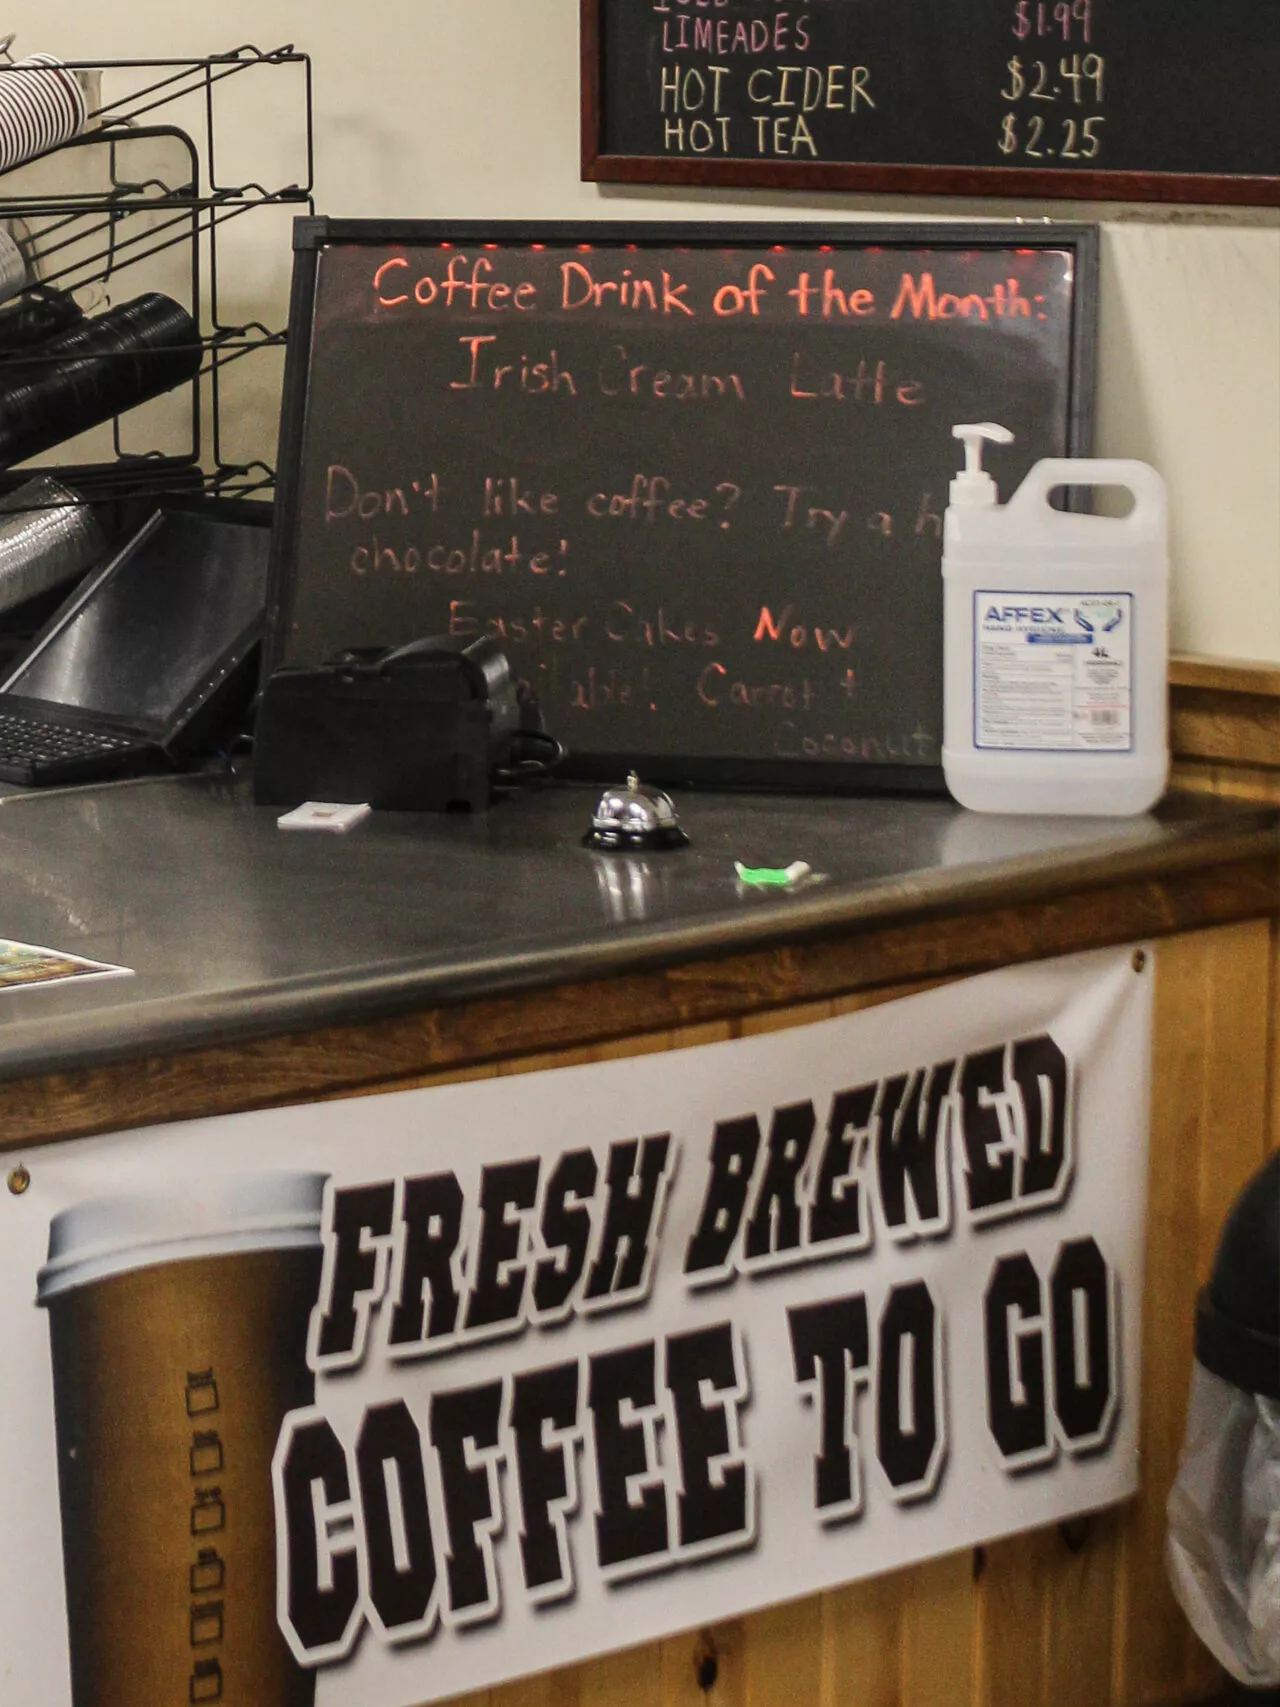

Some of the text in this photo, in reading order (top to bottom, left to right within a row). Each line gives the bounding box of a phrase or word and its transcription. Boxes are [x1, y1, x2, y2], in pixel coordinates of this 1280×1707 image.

[661, 0, 1092, 54] LIMEADES $1.99
[660, 53, 1105, 113] HOT CIDER $2.49
[664, 111, 1106, 158] HOT TEA $2.25
[373, 255, 1049, 322] Coffee Drink of the Month:
[449, 334, 925, 405] Irish Cream Latte
[324, 464, 442, 522] Don't
[483, 476, 559, 517] like
[585, 473, 742, 530] coffee?
[772, 484, 849, 548] Try
[868, 511, 893, 536] a
[350, 528, 569, 577] chocolate!
[448, 599, 589, 644] Easter
[752, 603, 855, 652] Now
[984, 606, 1065, 624] AFFEX
[314, 1031, 1070, 1362] FRESH BREWED
[278, 1320, 750, 1653] COFFEE
[785, 1278, 938, 1512] TO
[983, 1235, 1113, 1458] GO
